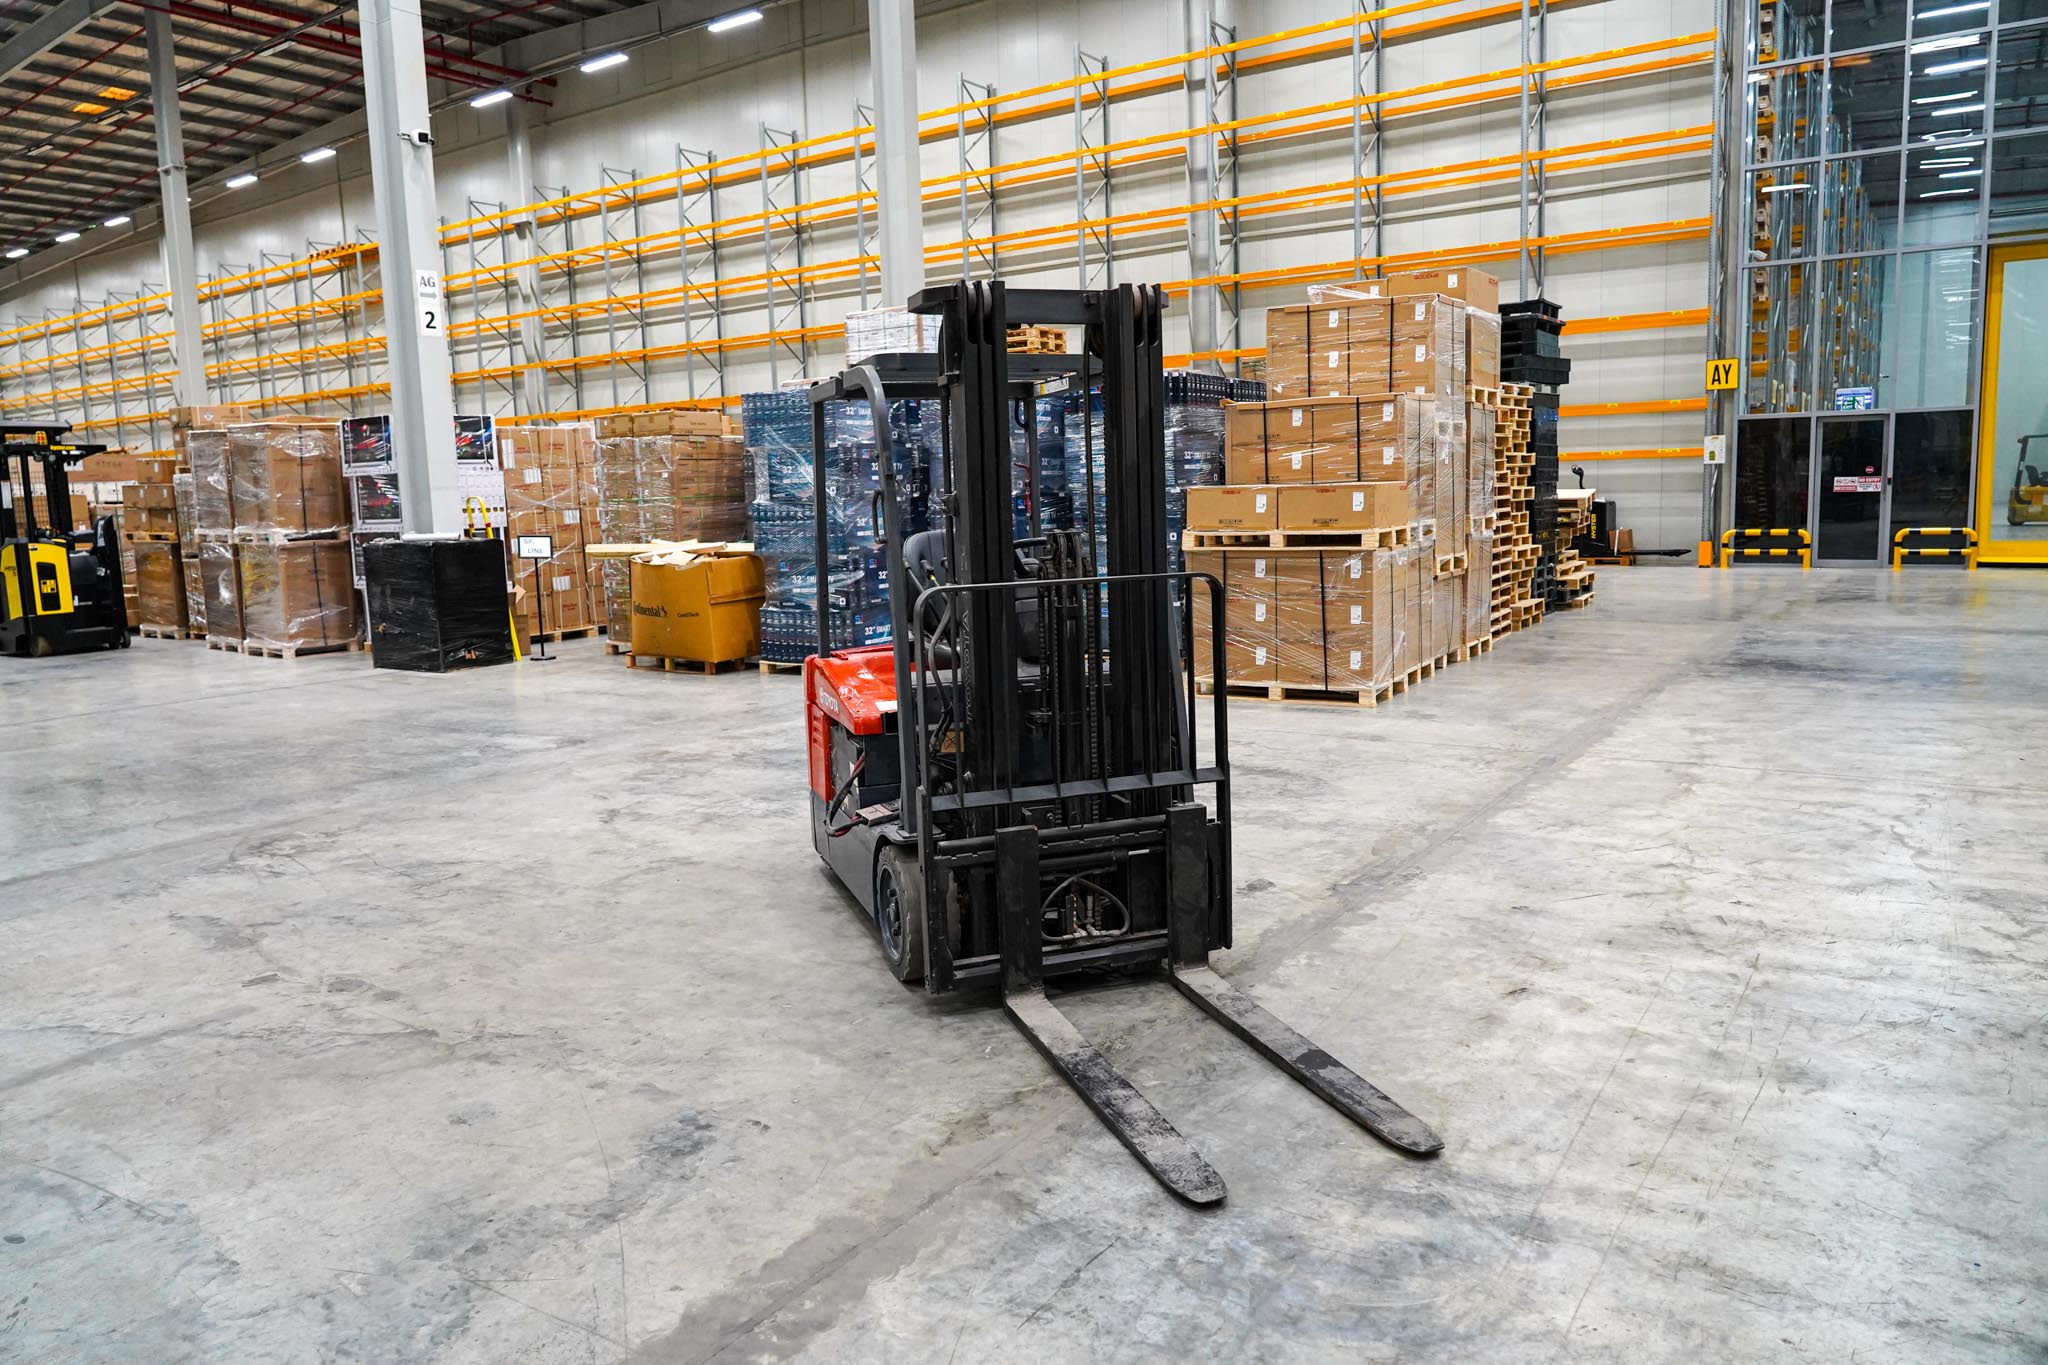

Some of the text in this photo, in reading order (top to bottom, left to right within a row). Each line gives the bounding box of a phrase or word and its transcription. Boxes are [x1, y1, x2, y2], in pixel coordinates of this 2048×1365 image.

[420, 276, 436, 287] AG
[425, 311, 437, 329] 2
[1711, 363, 1732, 385] AY
[858, 407, 871, 415] SMAR
[962, 609, 972, 723] TOYOTA
